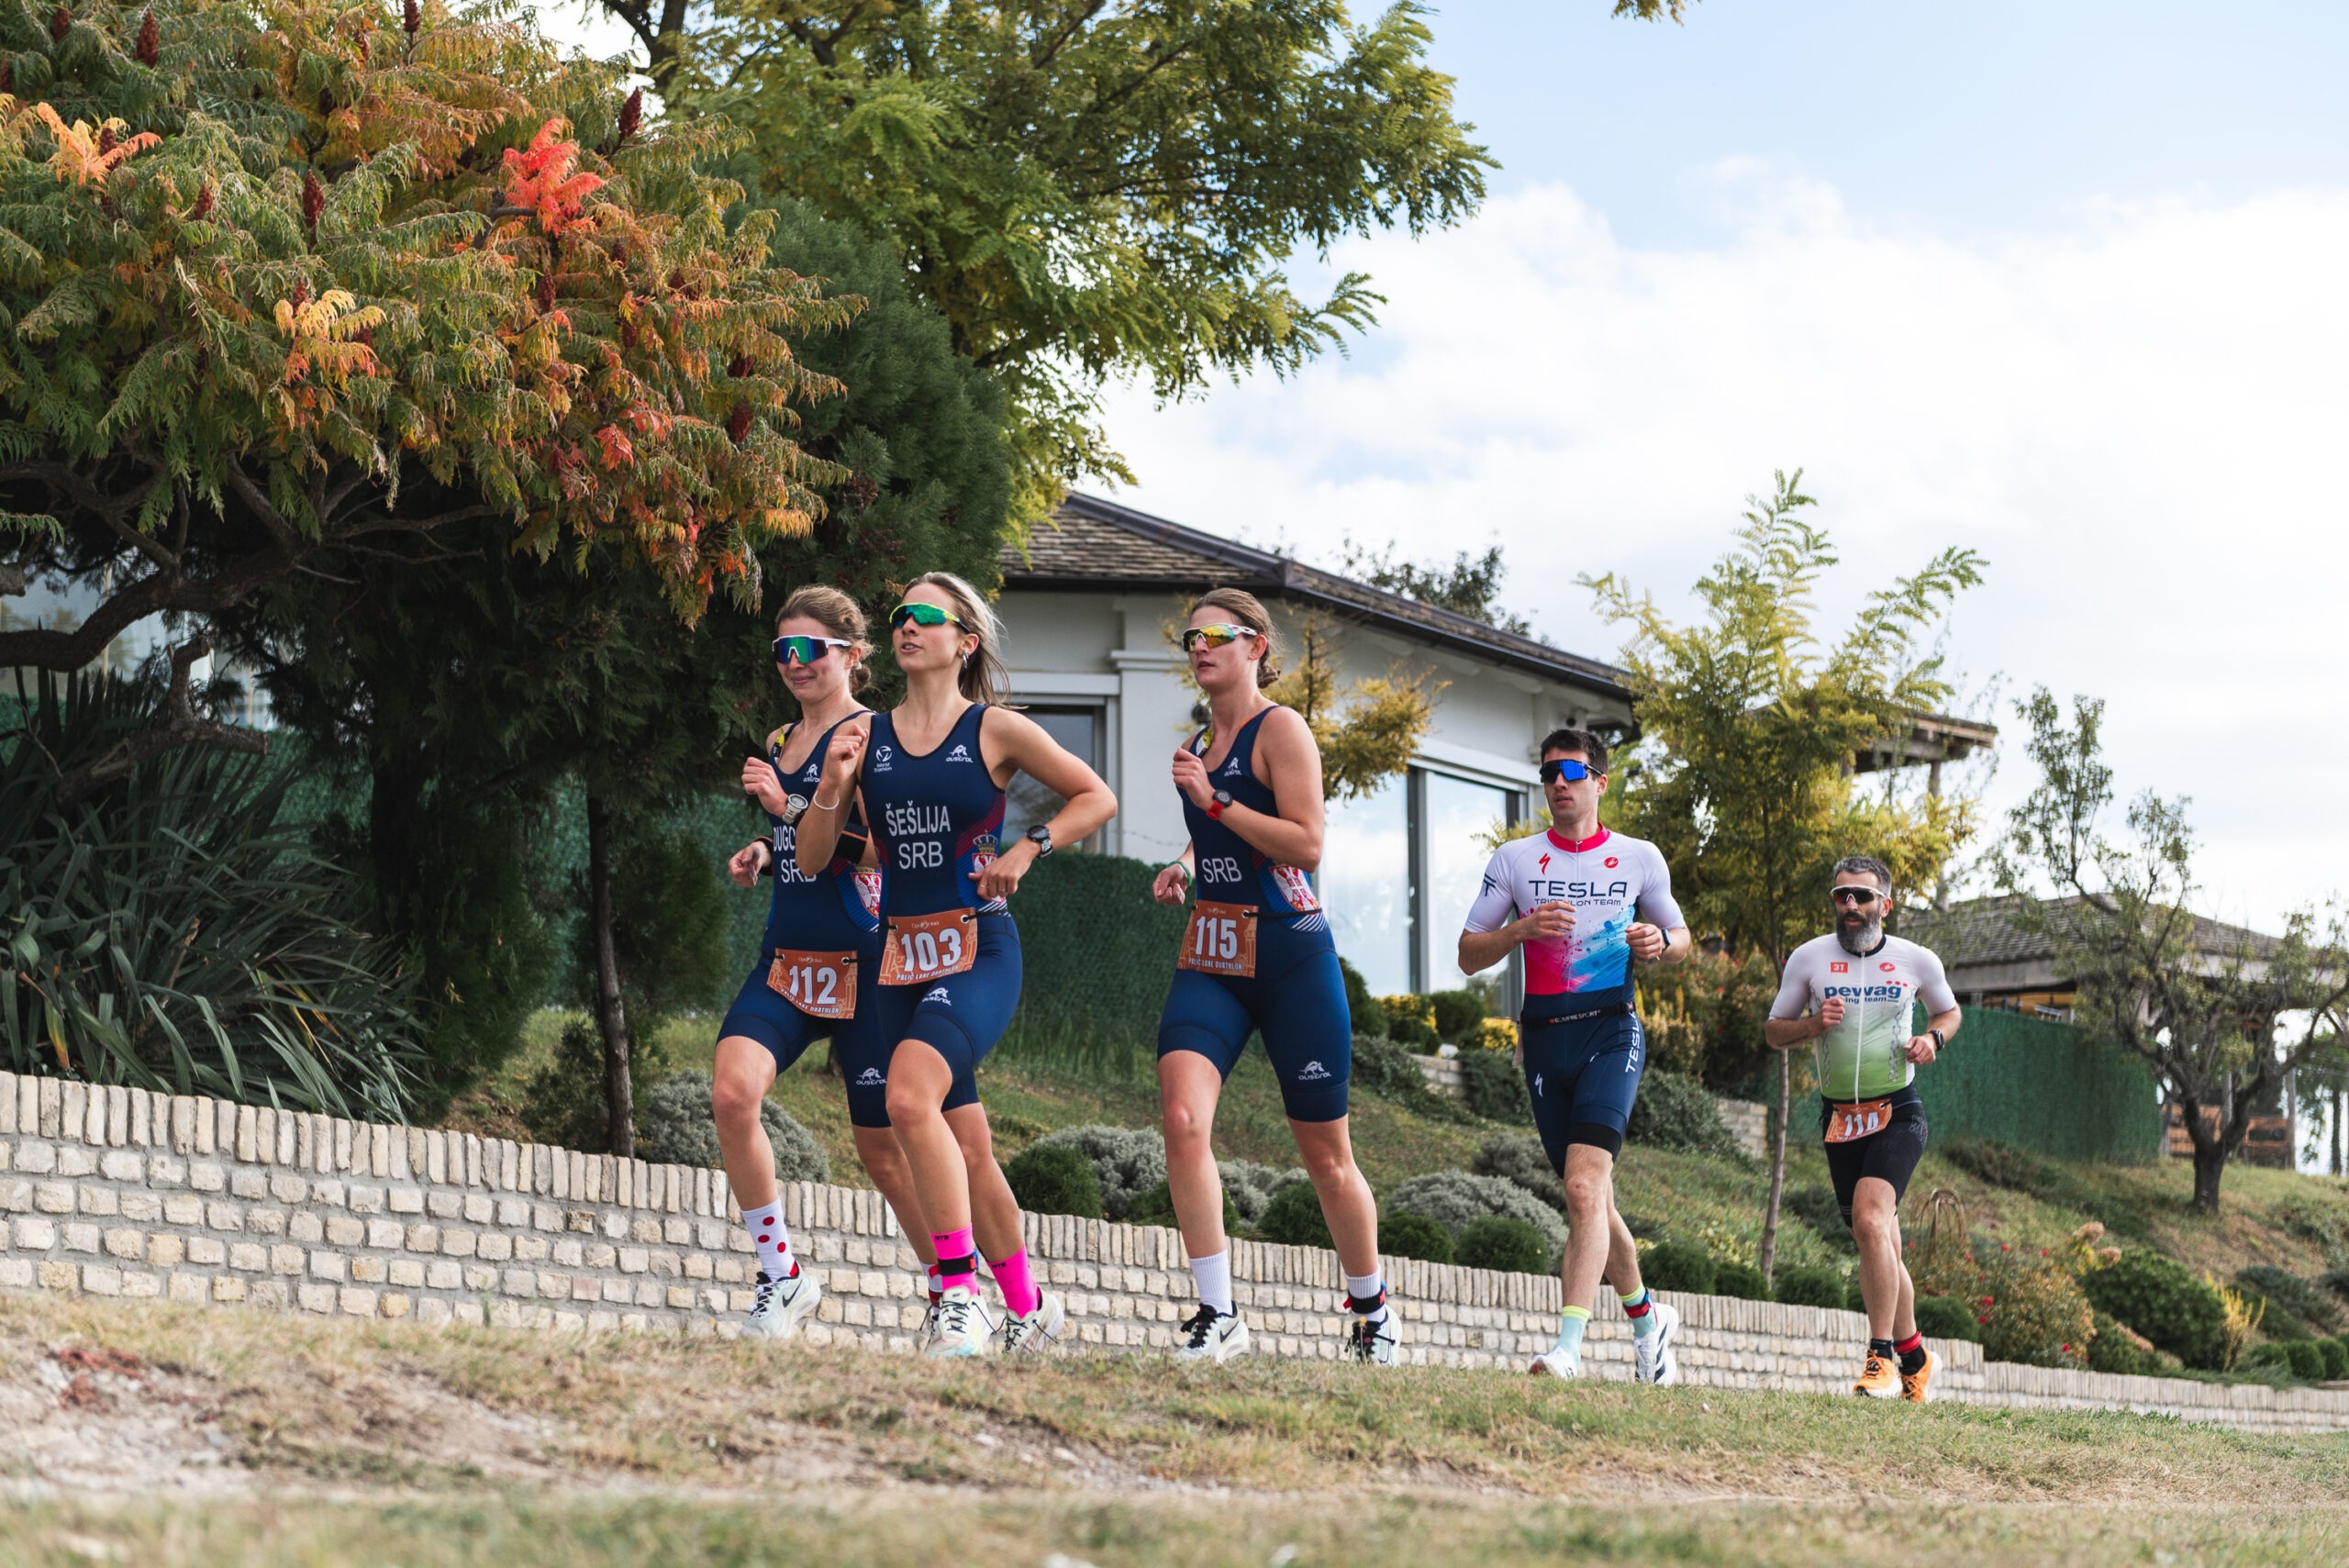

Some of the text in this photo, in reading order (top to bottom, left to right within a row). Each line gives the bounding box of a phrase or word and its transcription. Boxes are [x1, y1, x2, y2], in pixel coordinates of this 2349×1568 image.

[885, 800, 952, 837] ŠEŠLIJA
[898, 841, 943, 870] SRB
[1202, 857, 1242, 884] SRB
[1528, 880, 1628, 898] TESLA
[901, 928, 962, 973] 103
[1195, 916, 1237, 960] 115
[789, 965, 837, 1005] 112
[1824, 985, 1901, 999] pewag
